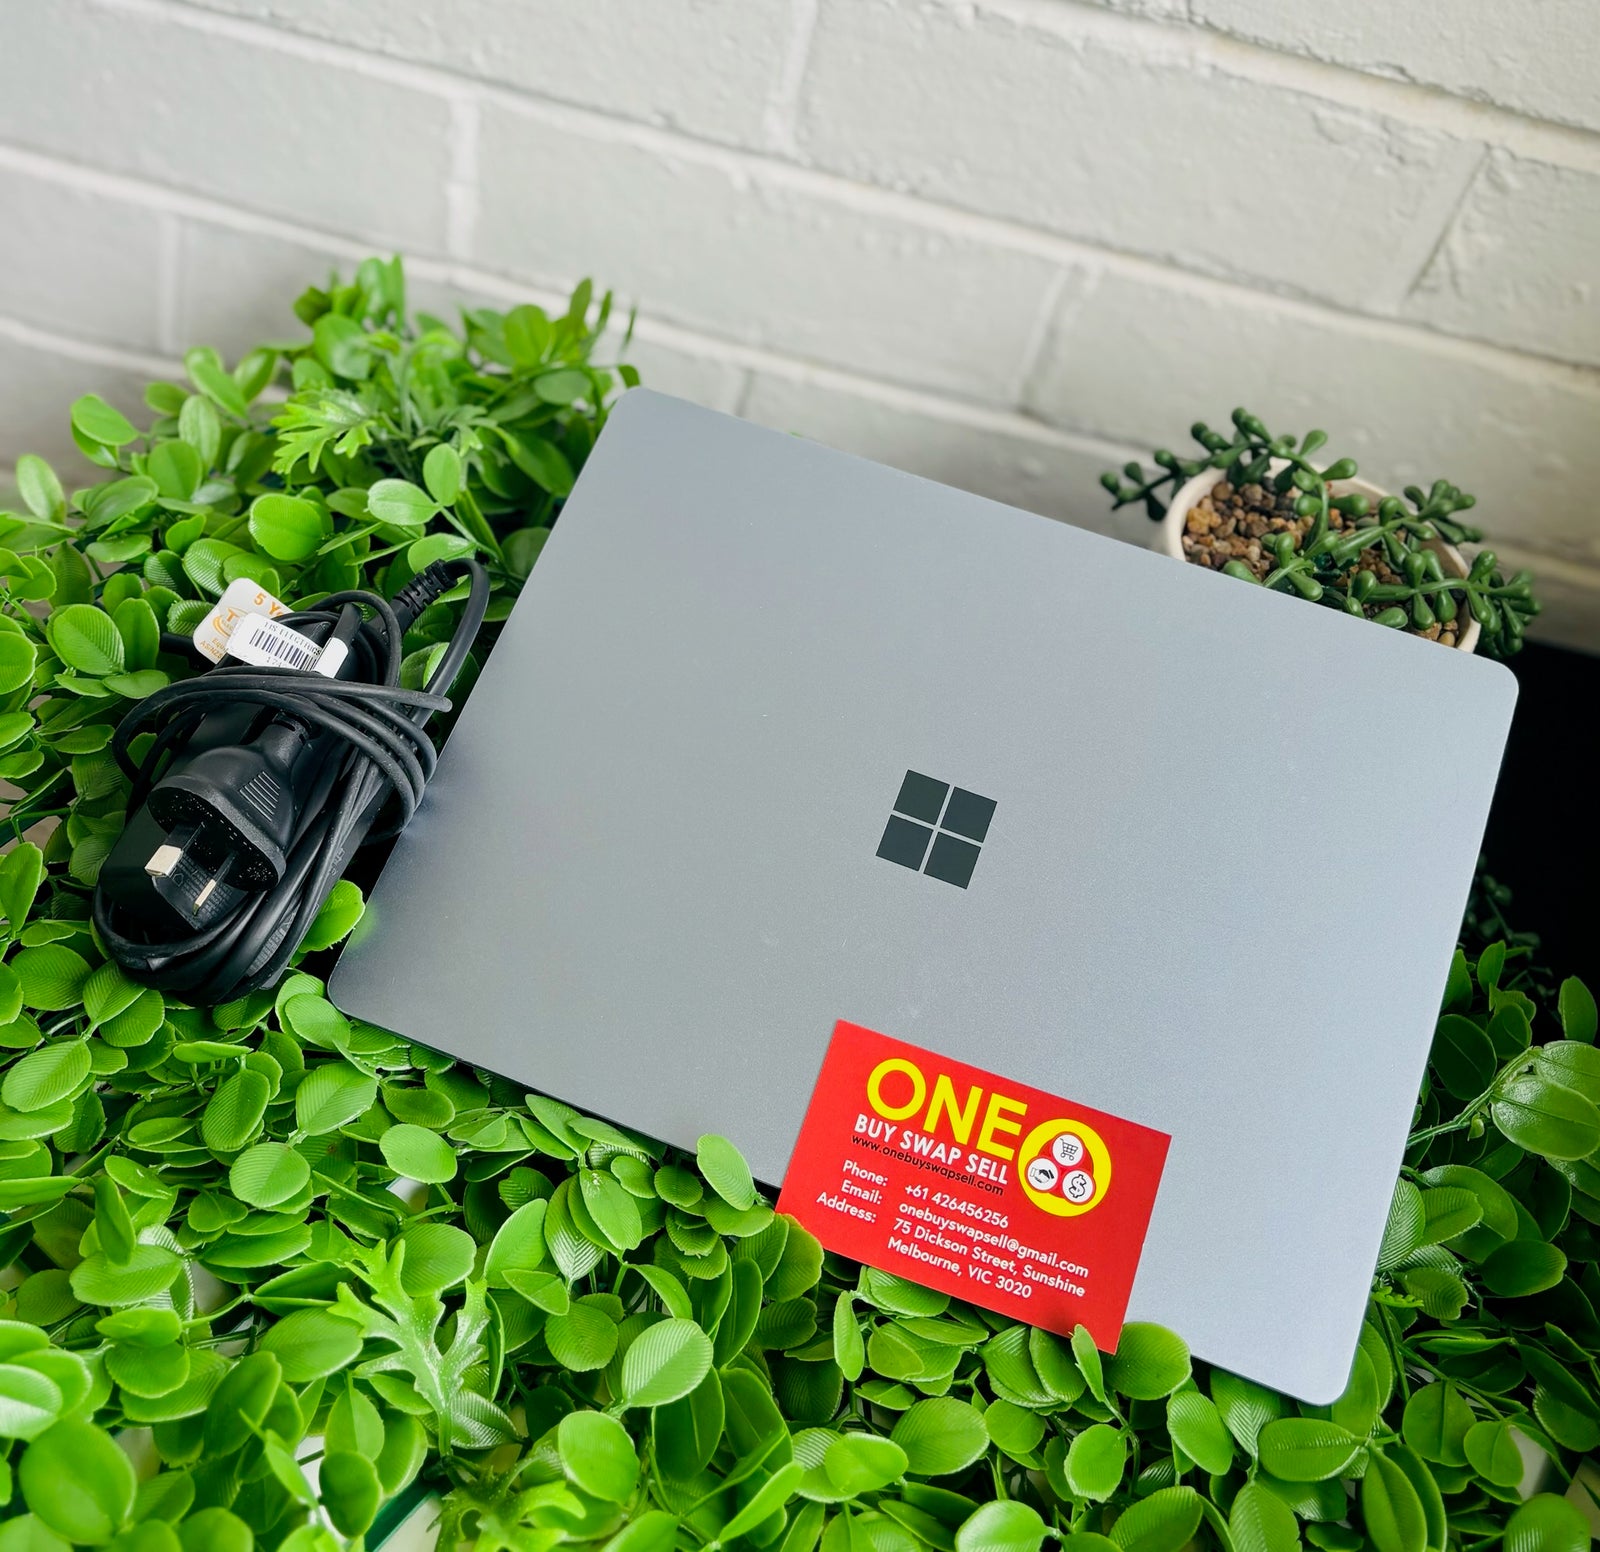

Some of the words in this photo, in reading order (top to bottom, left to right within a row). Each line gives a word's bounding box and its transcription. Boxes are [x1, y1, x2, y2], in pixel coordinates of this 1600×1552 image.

[253, 592, 267, 606] 5
[867, 1058, 1028, 1161] ONE
[852, 1135, 1004, 1196] www.onebuyswapsell.com
[854, 1113, 897, 1143] BUY
[900, 1130, 962, 1166] SWAP
[965, 1153, 1008, 1185] SELL
[841, 1179, 883, 1205] Email:
[898, 1202, 1089, 1278] onebuyswapsell@gmail.com
[842, 1159, 888, 1187] Phone:
[904, 1184, 929, 1200] +61
[931, 1191, 1009, 1229] 426456256
[816, 1191, 877, 1224] Address:
[893, 1217, 912, 1235] 75
[913, 1224, 968, 1256] Dickson
[972, 1246, 1018, 1276] Street,
[1022, 1264, 1085, 1297] Sunshine
[887, 1236, 962, 1277] Melbourne,
[967, 1264, 993, 1285] VIC
[995, 1275, 1032, 1299] 3020
